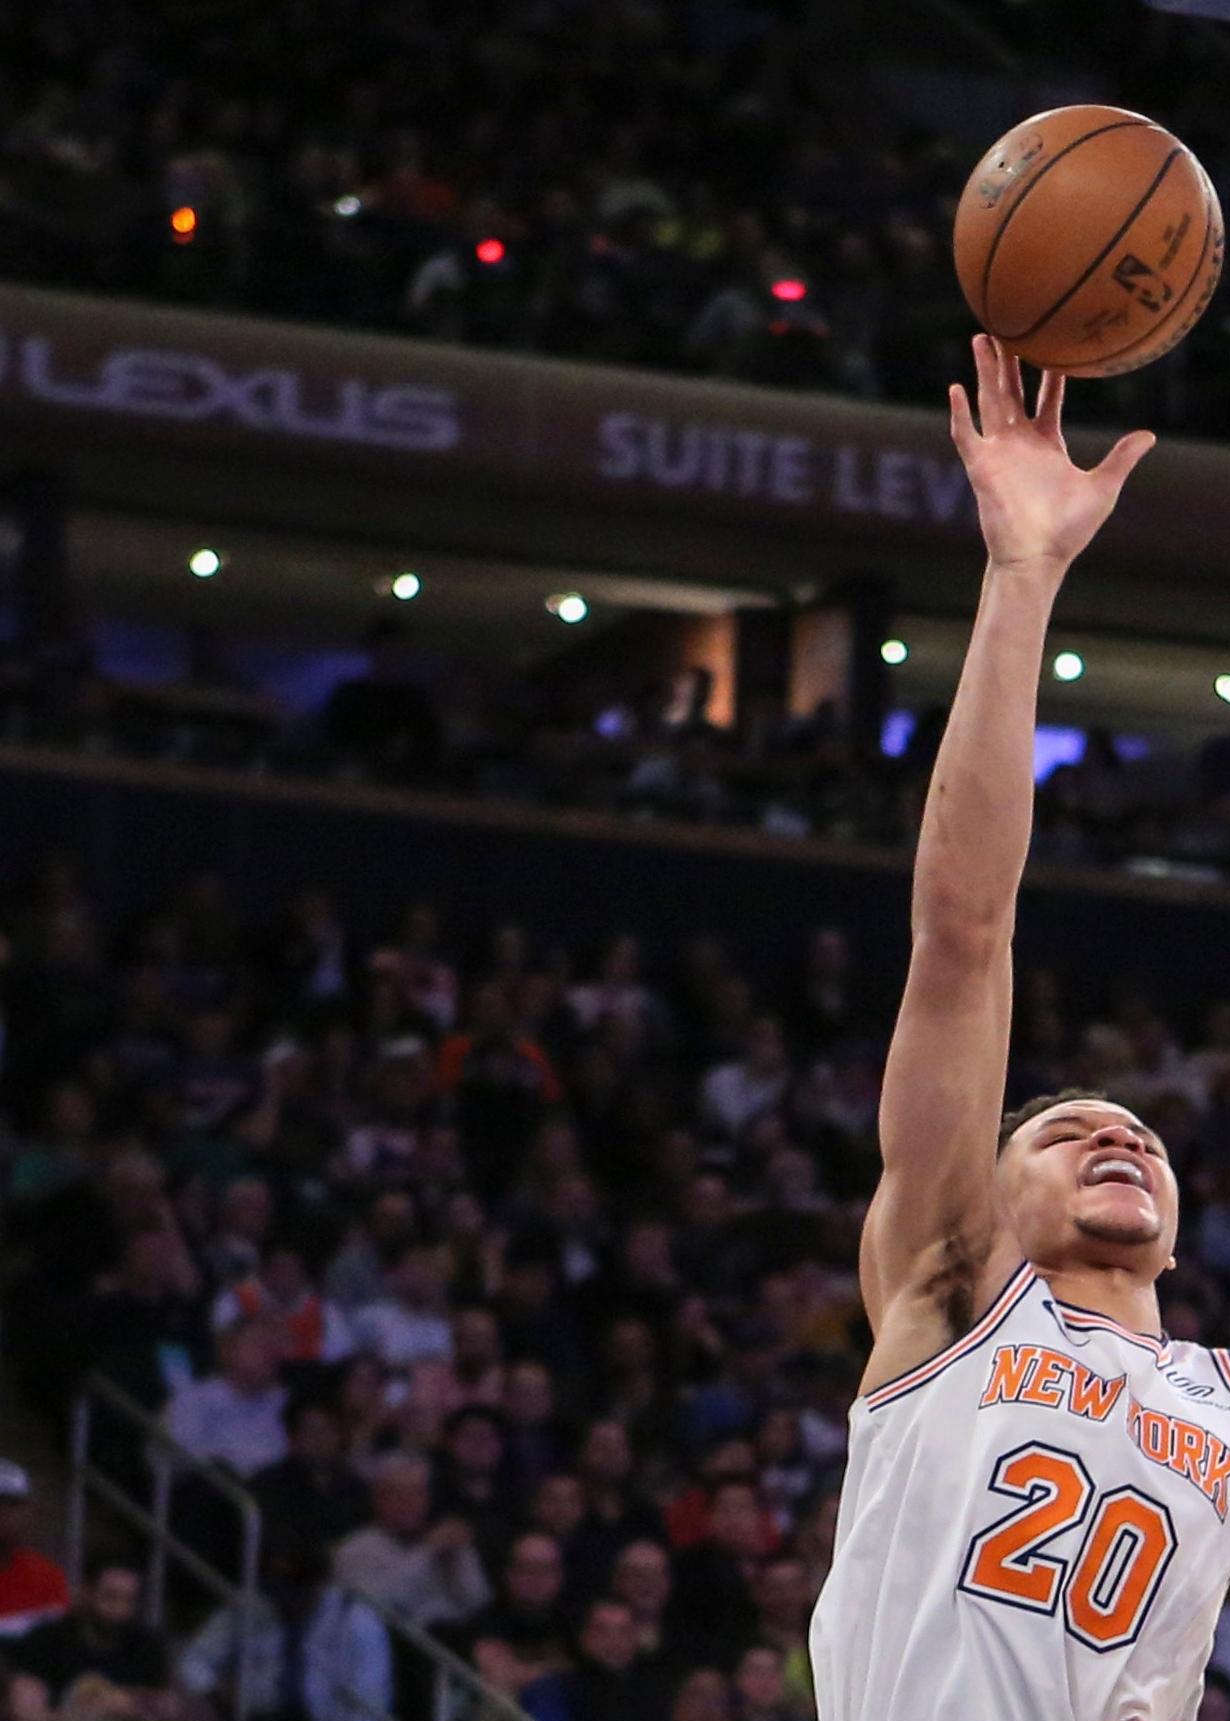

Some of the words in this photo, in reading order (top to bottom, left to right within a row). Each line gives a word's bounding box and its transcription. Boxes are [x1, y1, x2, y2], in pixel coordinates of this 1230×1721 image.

[21, 336, 459, 452] LEXUS
[601, 412, 812, 503] SUITE
[836, 444, 975, 522] LEV
[978, 1344, 1127, 1422] NEW
[958, 1440, 1179, 1654] 20
